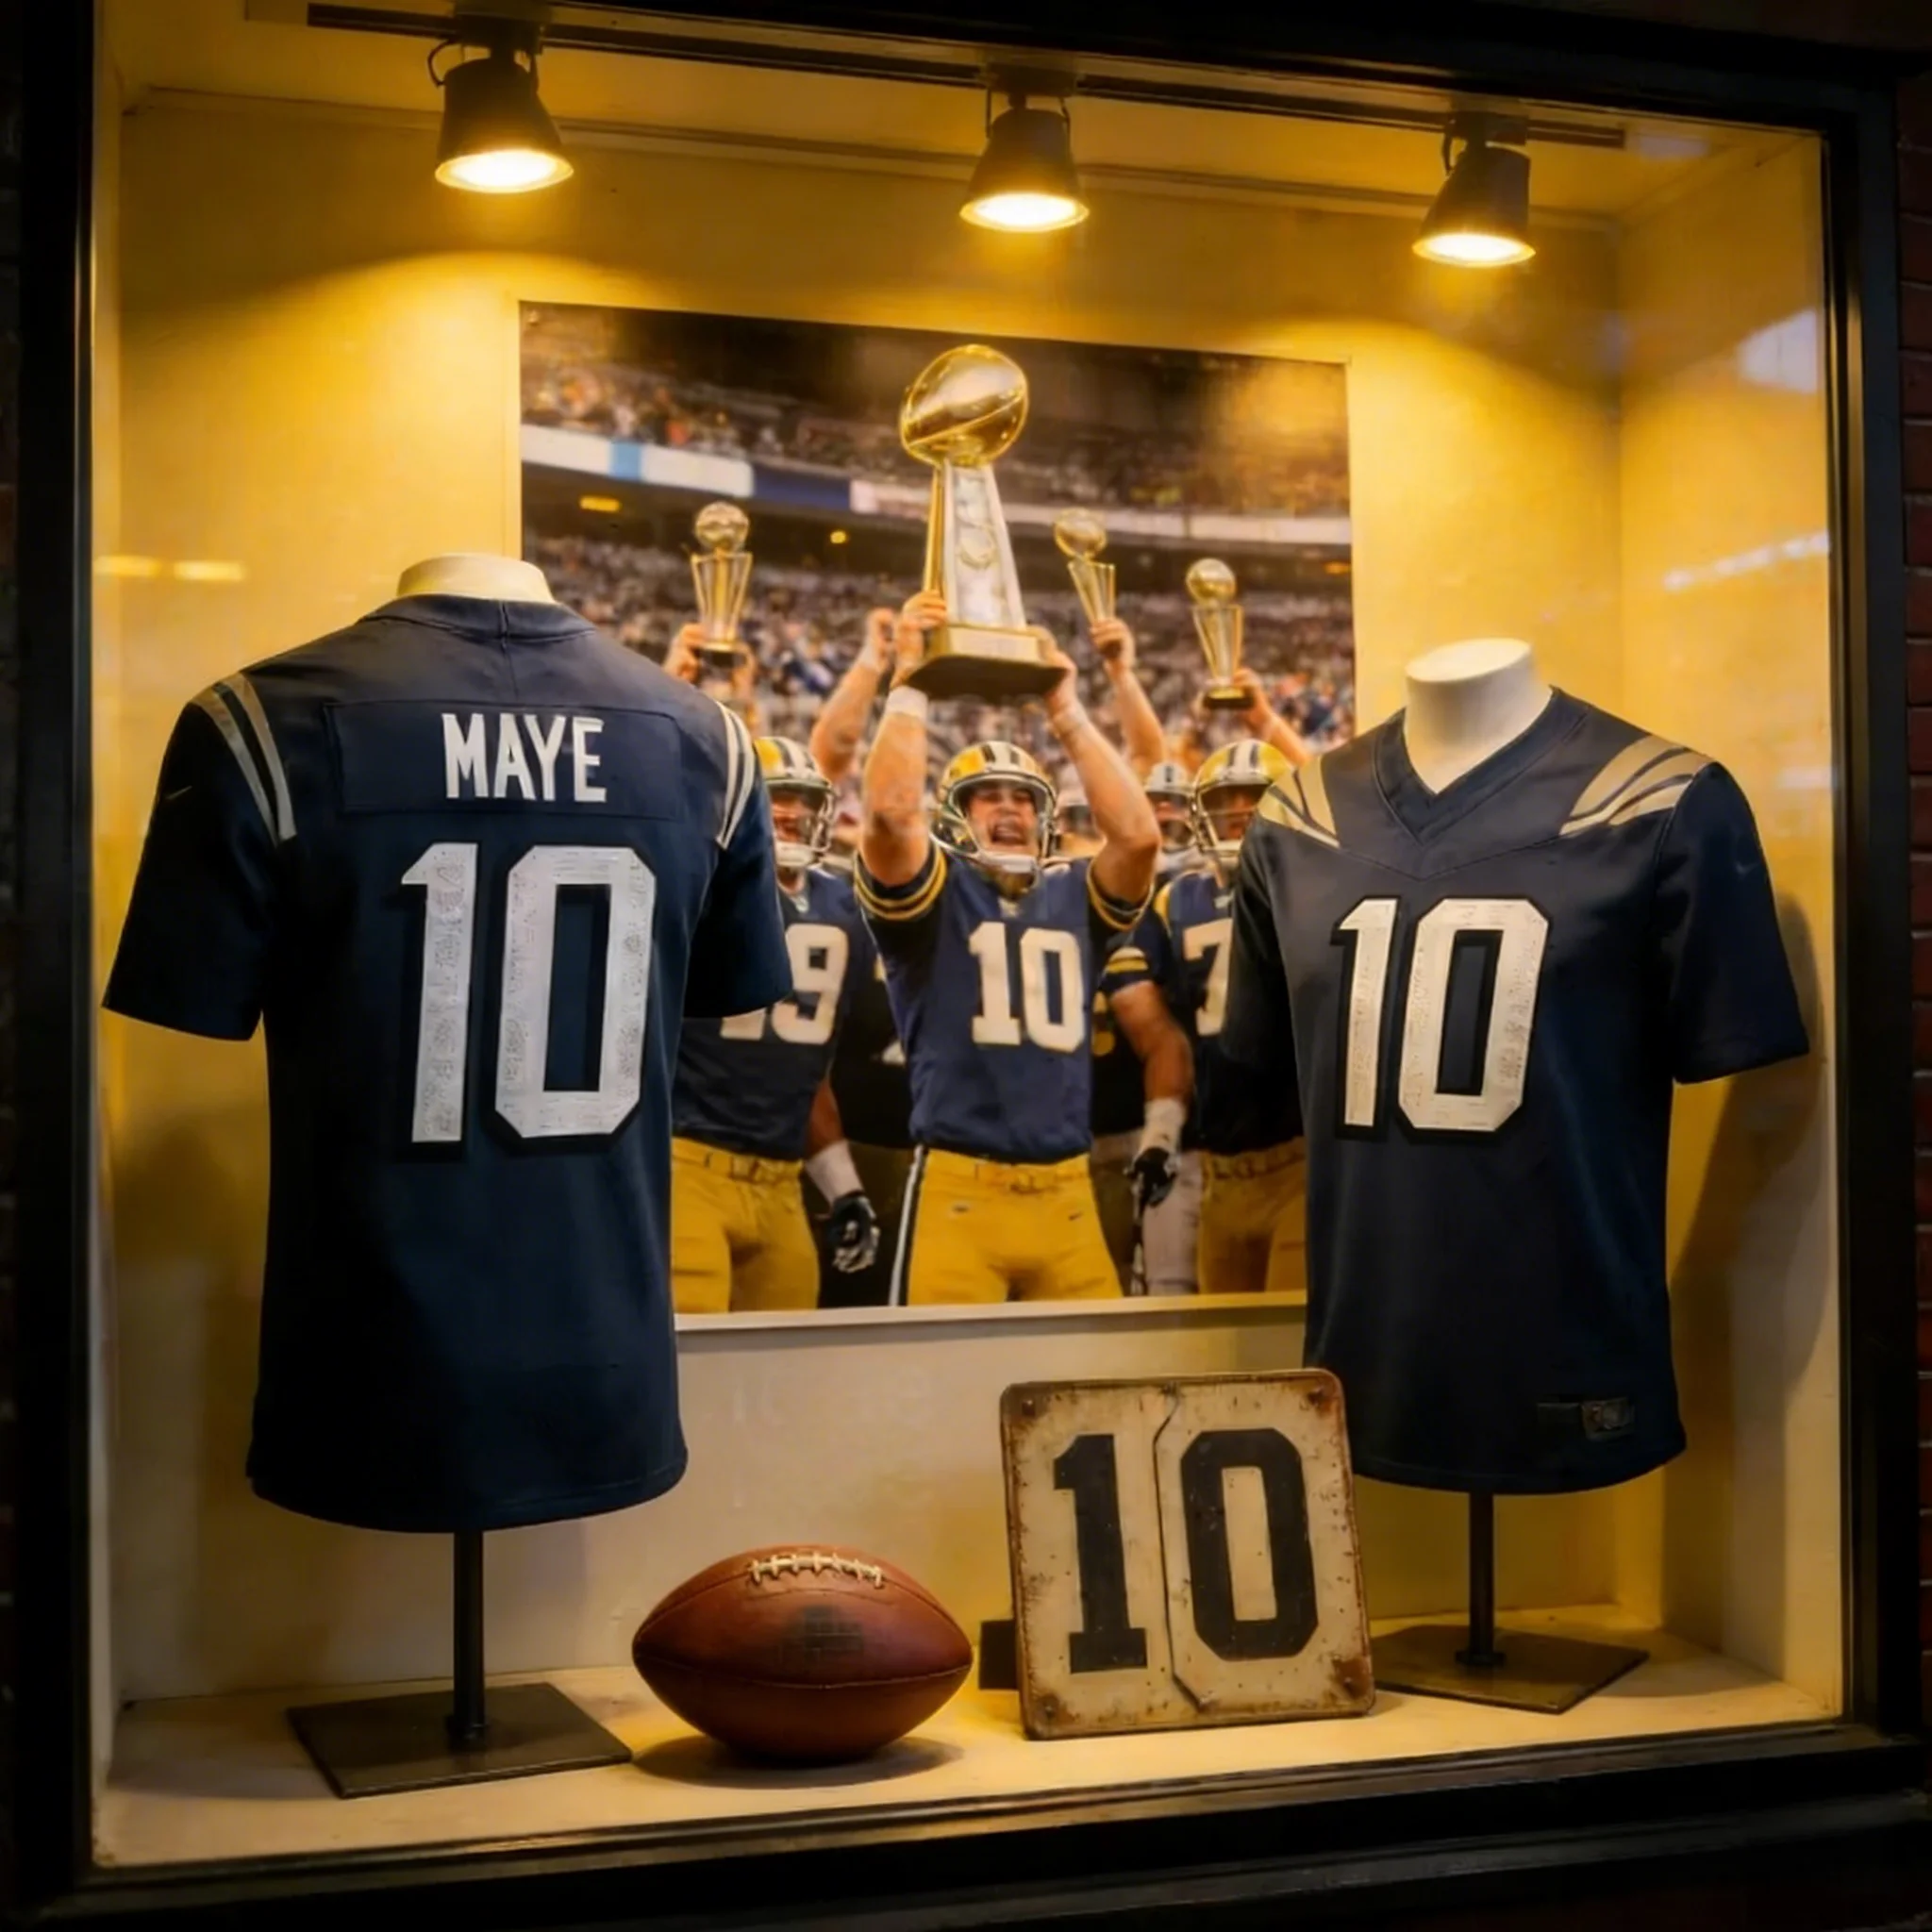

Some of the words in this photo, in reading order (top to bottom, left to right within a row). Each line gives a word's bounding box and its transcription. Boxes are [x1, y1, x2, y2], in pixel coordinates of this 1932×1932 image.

[441, 712, 607, 803] MAYE
[400, 842, 657, 1143] 10
[721, 923, 849, 1044] 9
[969, 922, 1084, 1052] 10
[1338, 898, 1549, 1132] 10
[1053, 1427, 1319, 1674] 10
